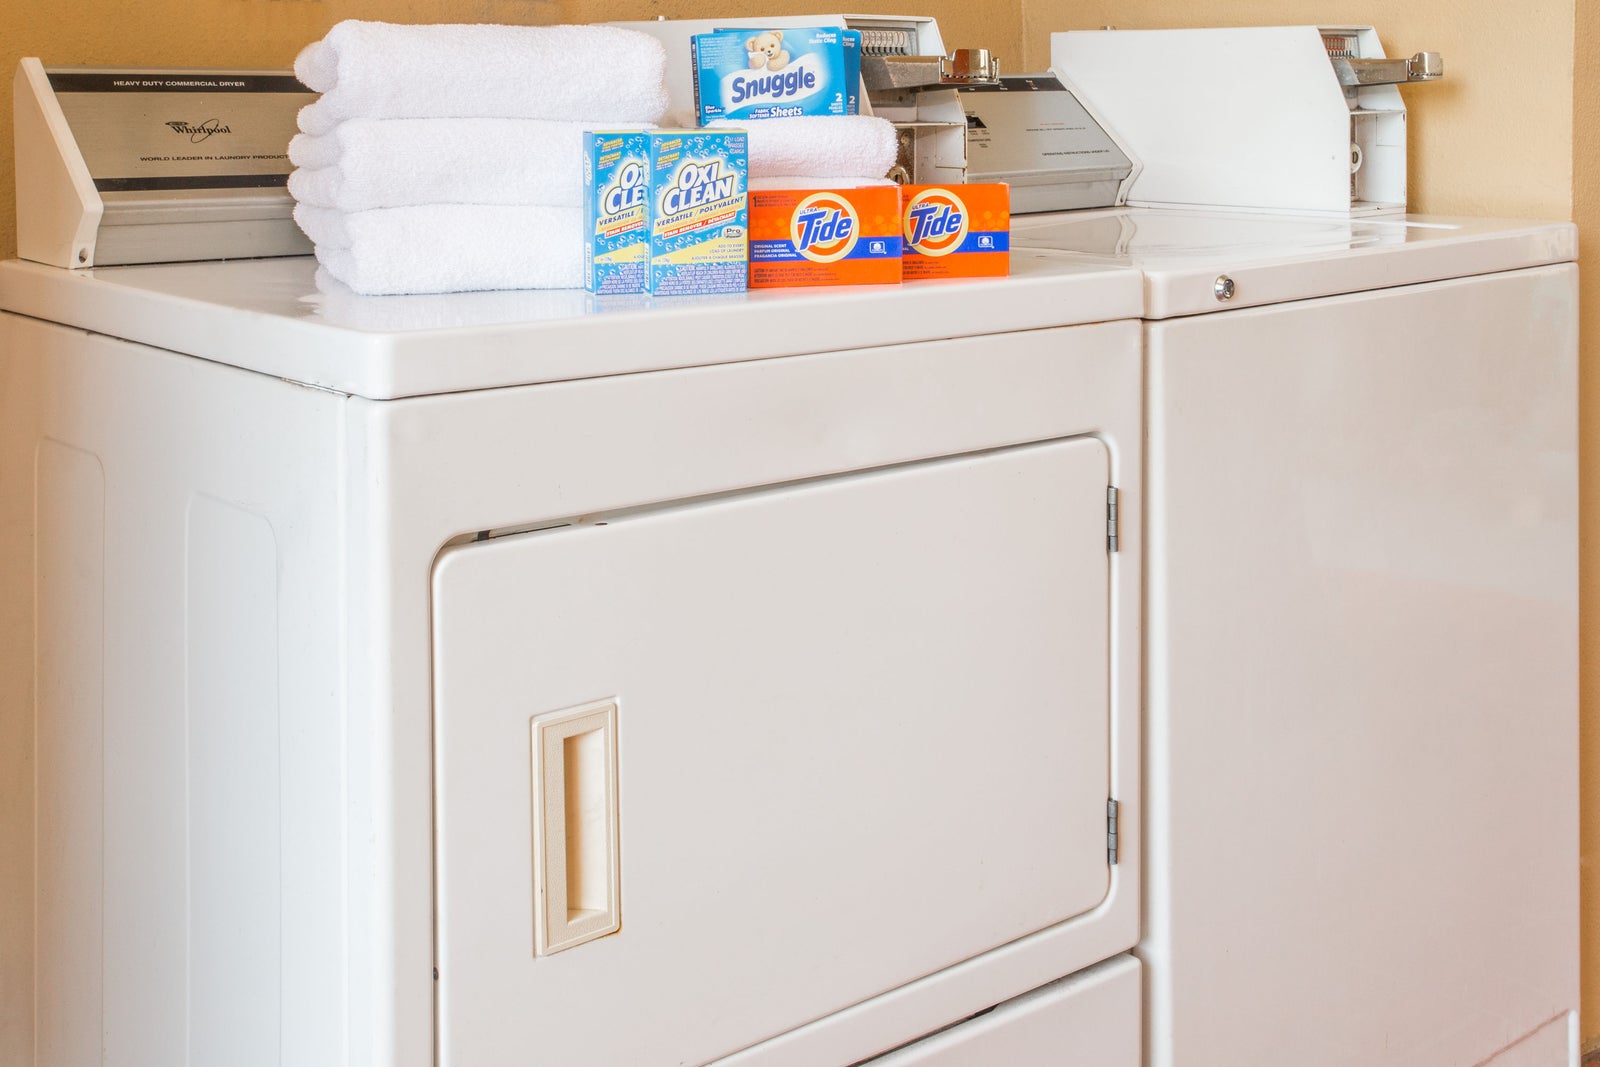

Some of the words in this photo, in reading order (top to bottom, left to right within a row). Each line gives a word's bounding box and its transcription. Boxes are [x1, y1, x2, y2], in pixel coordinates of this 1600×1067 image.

[732, 66, 816, 103] Snuggle
[836, 92, 842, 102] 2
[849, 96, 856, 104] 2
[770, 106, 802, 118] Sheets
[168, 120, 232, 139] Whirlpool
[678, 161, 720, 191] OXI
[662, 174, 734, 216] CLEAN
[753, 196, 757, 208] 1
[599, 210, 635, 226] VERSATILE
[656, 211, 693, 226] VERSATILE
[700, 196, 744, 214] POLYVALENT
[679, 222, 702, 232] REMOVER
[797, 209, 853, 252] Tide
[910, 204, 963, 246] Tide
